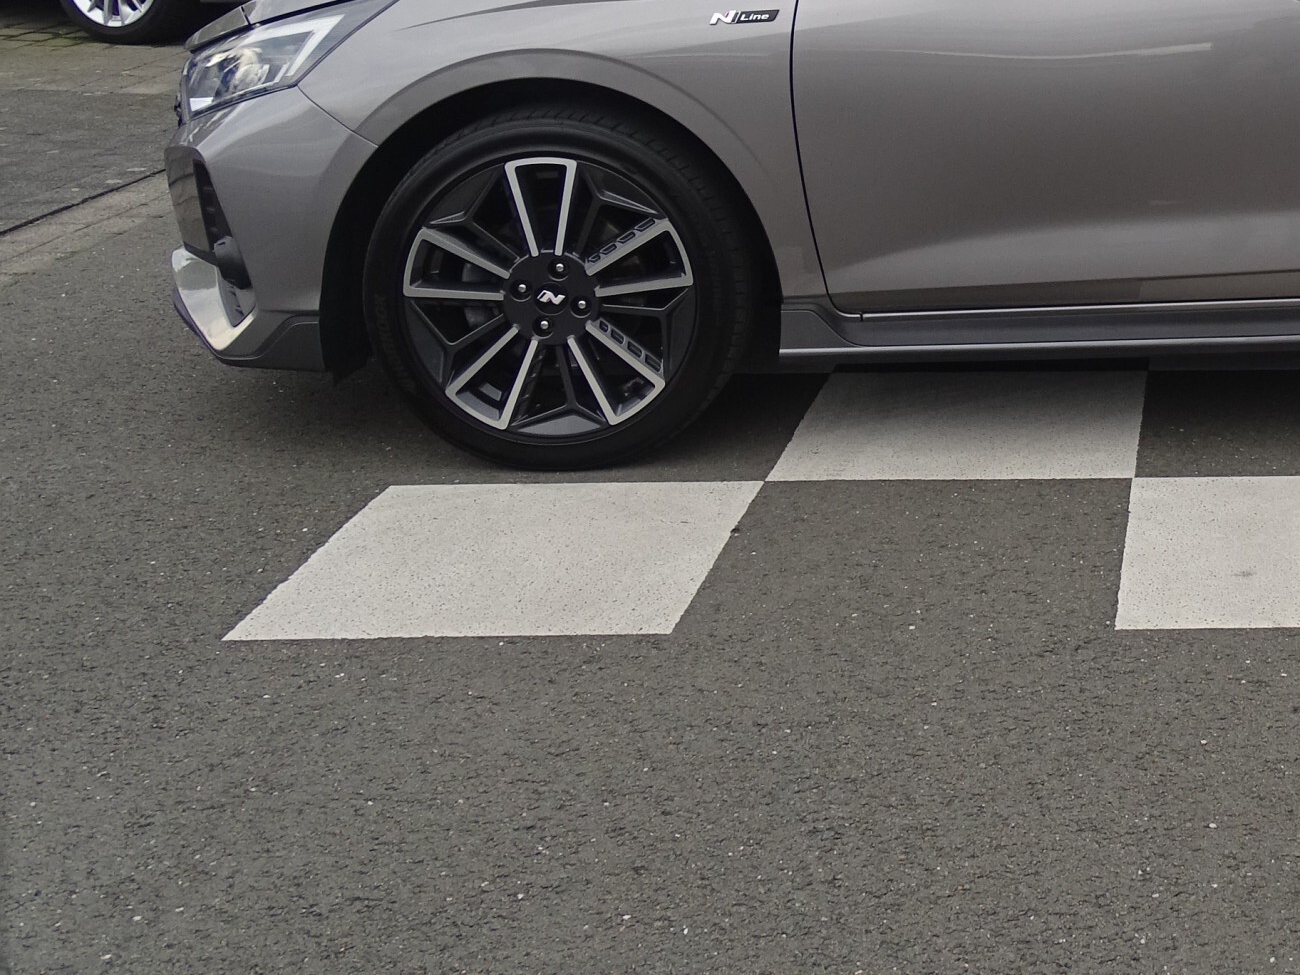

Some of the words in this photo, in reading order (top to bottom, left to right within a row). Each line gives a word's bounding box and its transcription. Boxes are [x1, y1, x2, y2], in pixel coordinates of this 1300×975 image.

[709, 10, 737, 25] N
[740, 13, 770, 21] Line
[537, 290, 566, 305] N
